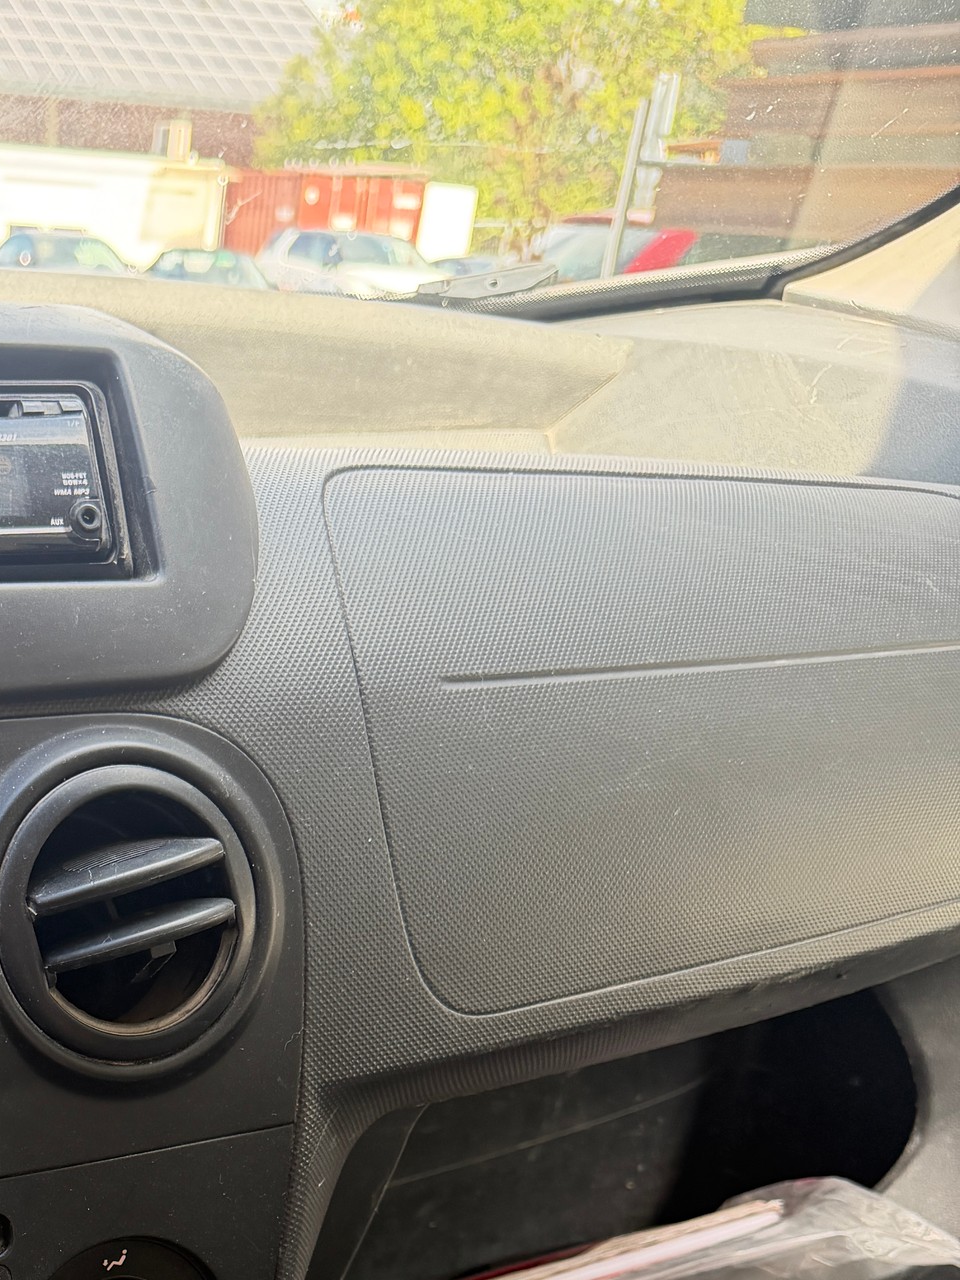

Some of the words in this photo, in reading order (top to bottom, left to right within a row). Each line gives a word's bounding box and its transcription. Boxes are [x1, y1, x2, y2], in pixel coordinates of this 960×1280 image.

[53, 488, 72, 496] WMA
[73, 487, 90, 496] MP3
[50, 516, 65, 526] AUX
